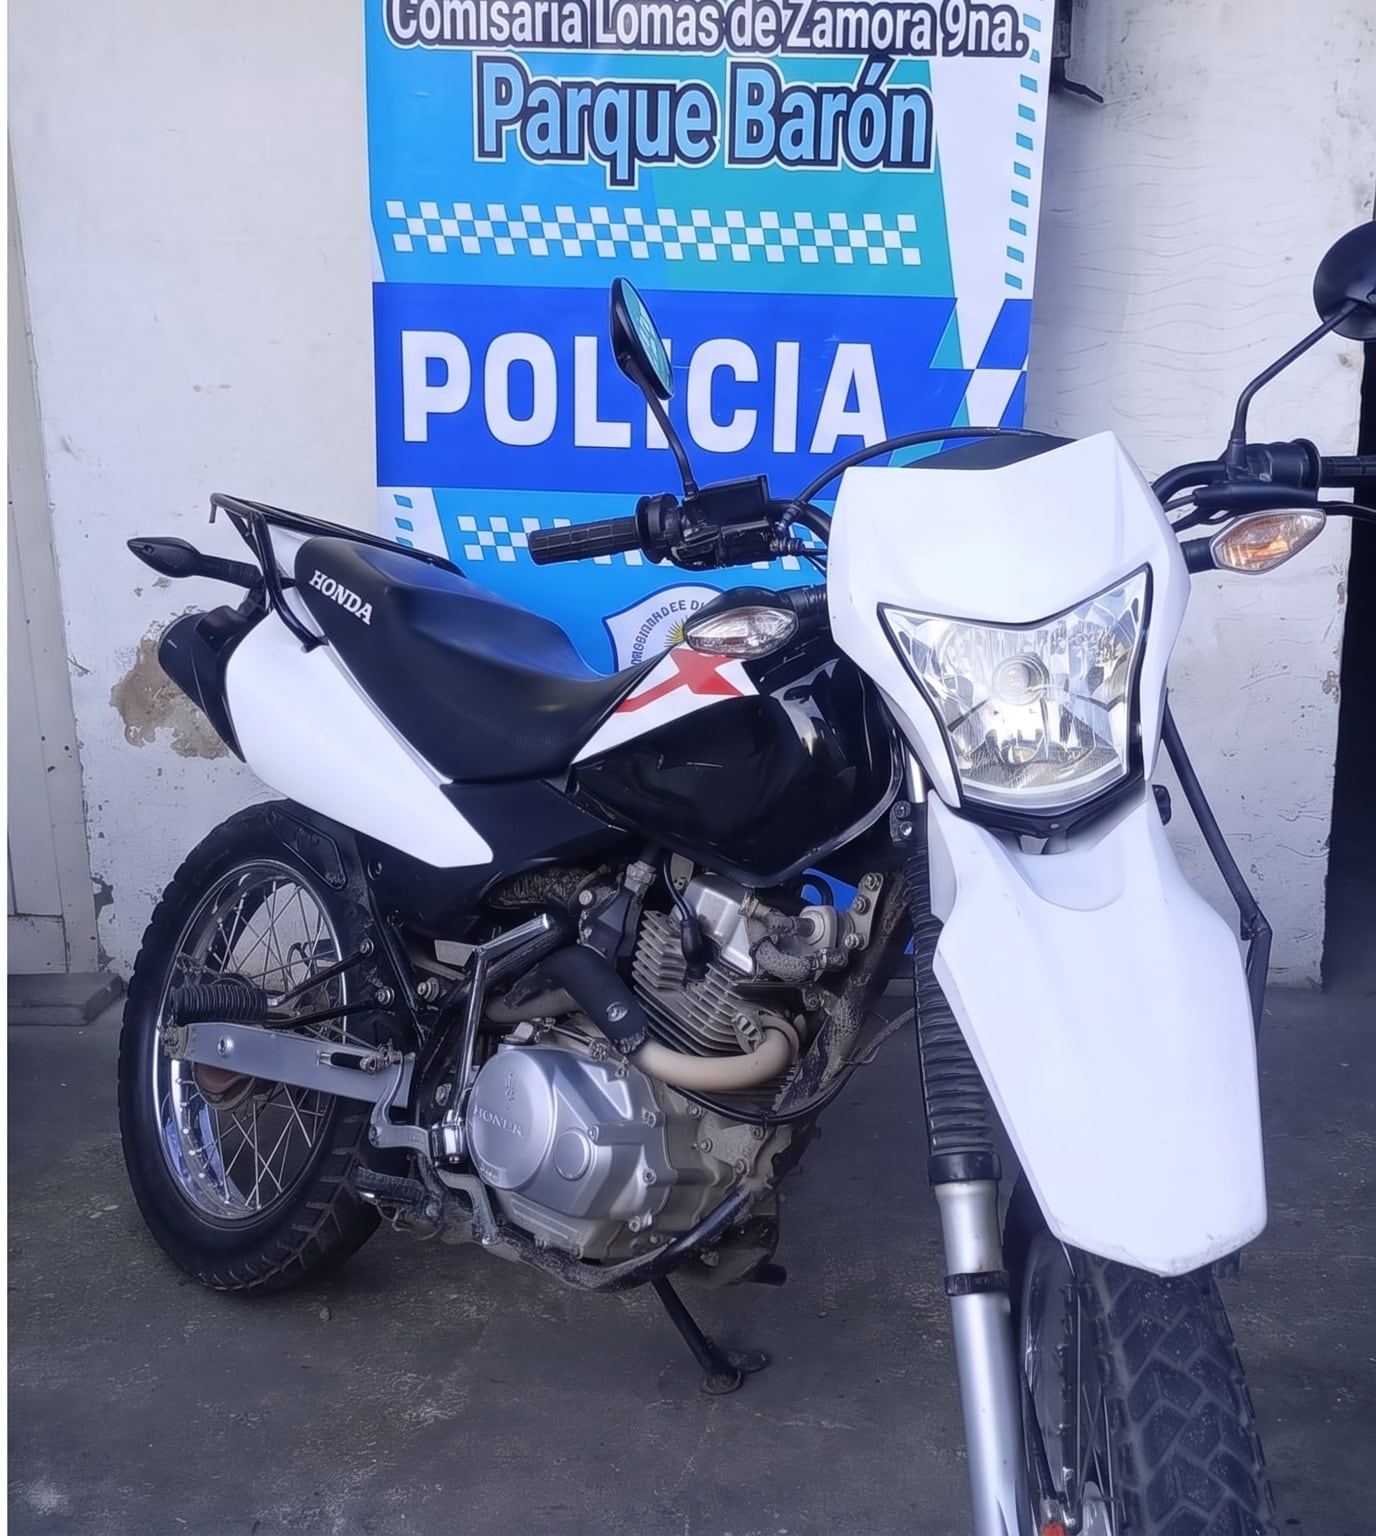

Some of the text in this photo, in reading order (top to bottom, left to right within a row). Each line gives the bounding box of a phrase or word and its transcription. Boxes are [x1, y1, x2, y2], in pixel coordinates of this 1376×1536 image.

[596, 0, 719, 47] Lomas
[730, 0, 777, 47] de
[787, 0, 931, 51] Zamora
[945, 0, 1024, 52] 9na.
[484, 62, 925, 180] Parque Barón
[401, 329, 888, 454] POLICIA
[309, 570, 373, 625] HONDA
